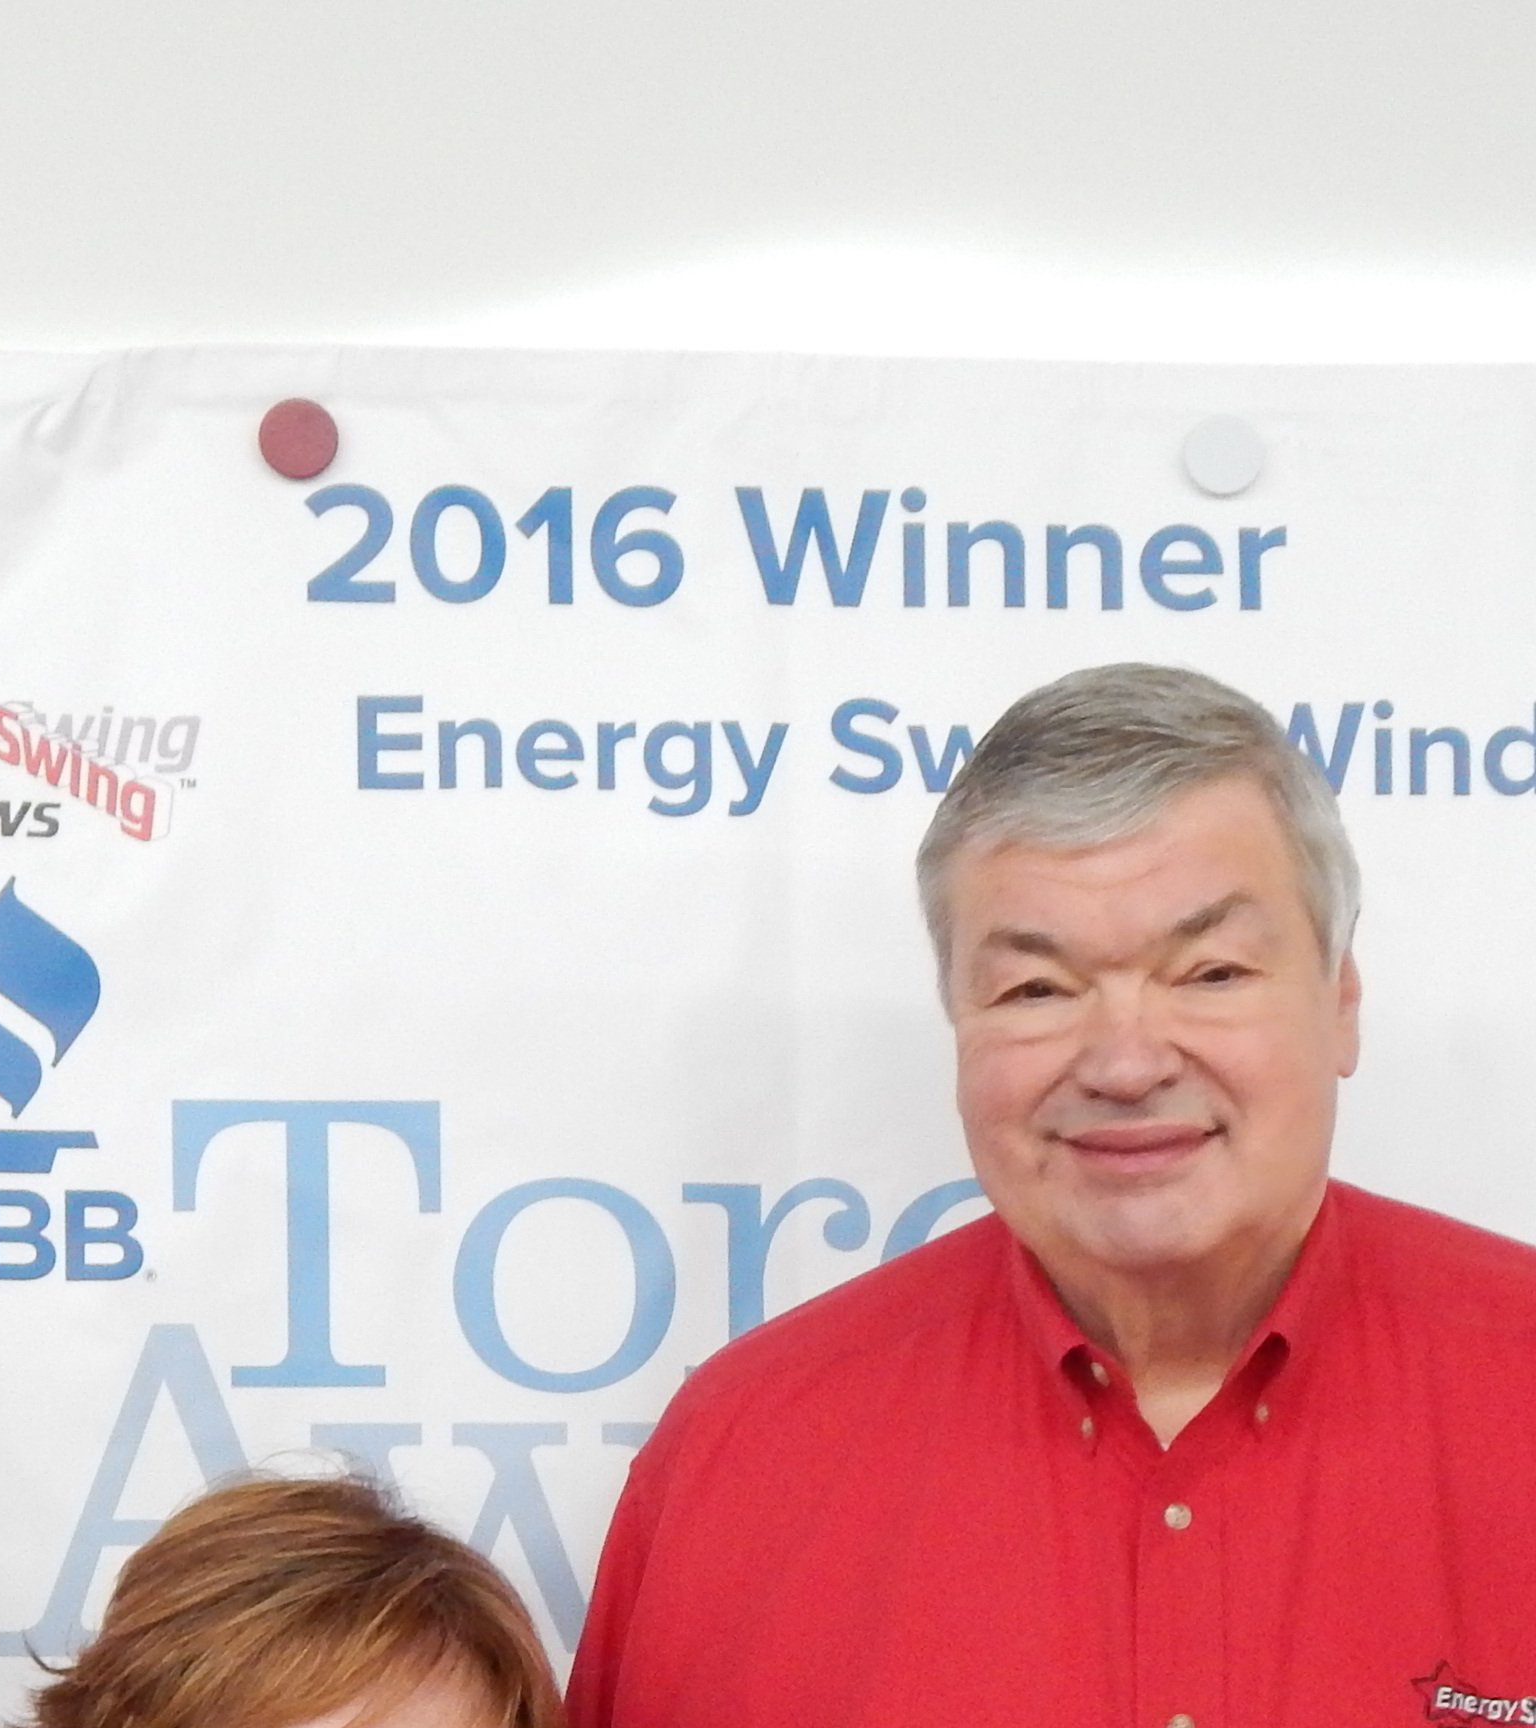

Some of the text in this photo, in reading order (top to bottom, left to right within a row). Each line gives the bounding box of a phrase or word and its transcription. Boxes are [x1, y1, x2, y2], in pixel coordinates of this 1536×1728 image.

[304, 483, 1287, 612] 2016 Winner
[356, 695, 790, 818] Energy
[1434, 1686, 1518, 1723] Energy
